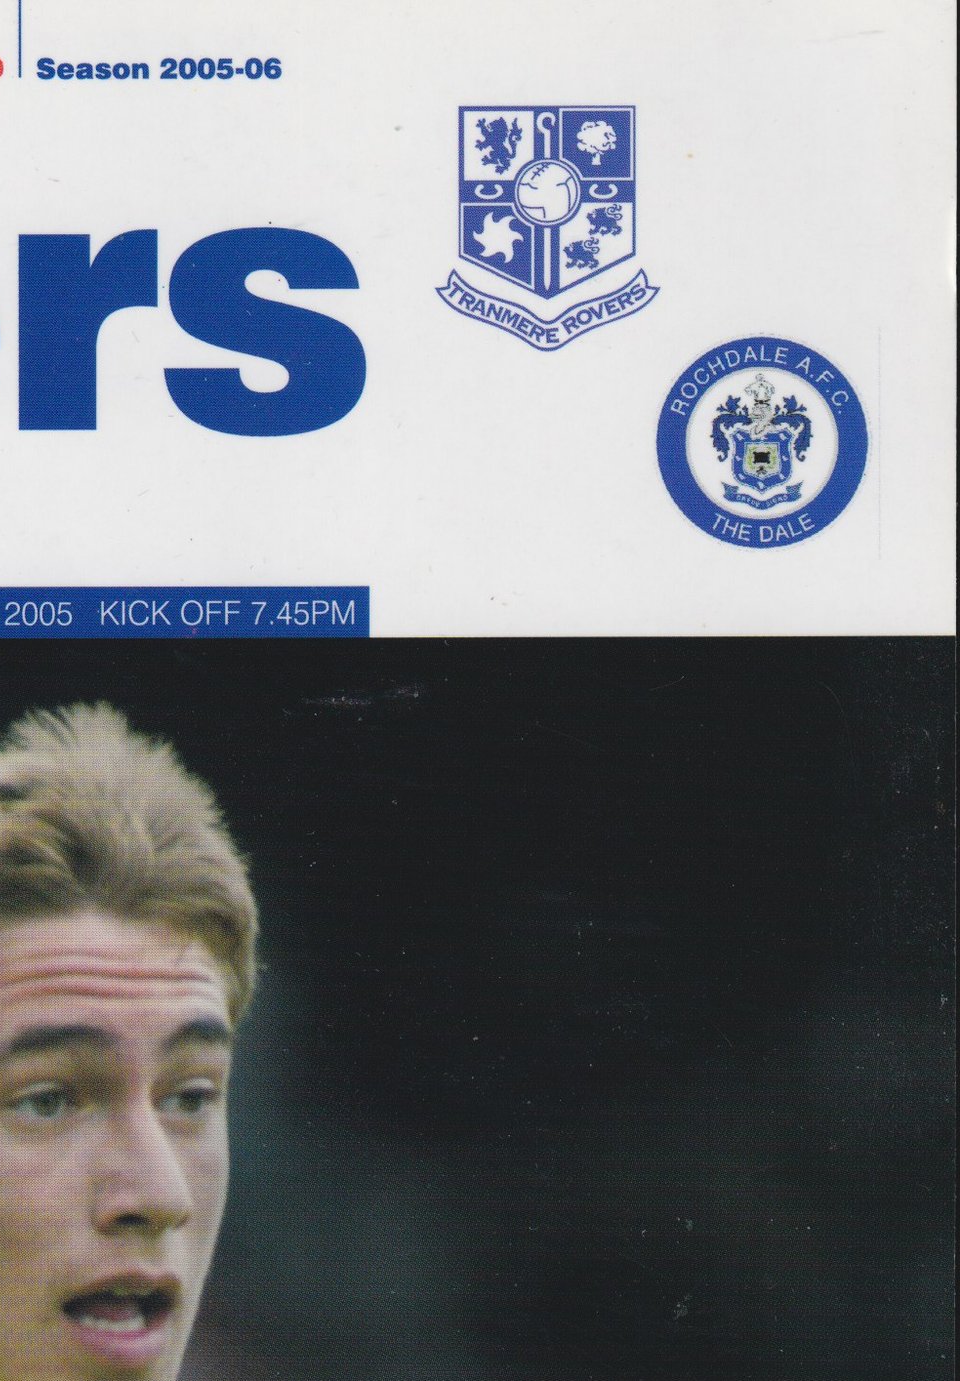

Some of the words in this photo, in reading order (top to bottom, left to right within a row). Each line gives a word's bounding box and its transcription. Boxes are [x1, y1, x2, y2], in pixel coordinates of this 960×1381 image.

[36, 57, 149, 81] Season
[159, 57, 283, 81] 2005-06
[449, 281, 559, 343] TRANMERE
[561, 283, 647, 335] ROVERS
[671, 345, 789, 415] ROCHDALE
[795, 356, 849, 414] A.F.C.
[711, 513, 753, 542] THE
[760, 512, 815, 543] DALE
[4, 600, 73, 627] 2005
[100, 600, 171, 626] KICK
[180, 600, 241, 626] OFF
[251, 599, 355, 626] 7.45PM
